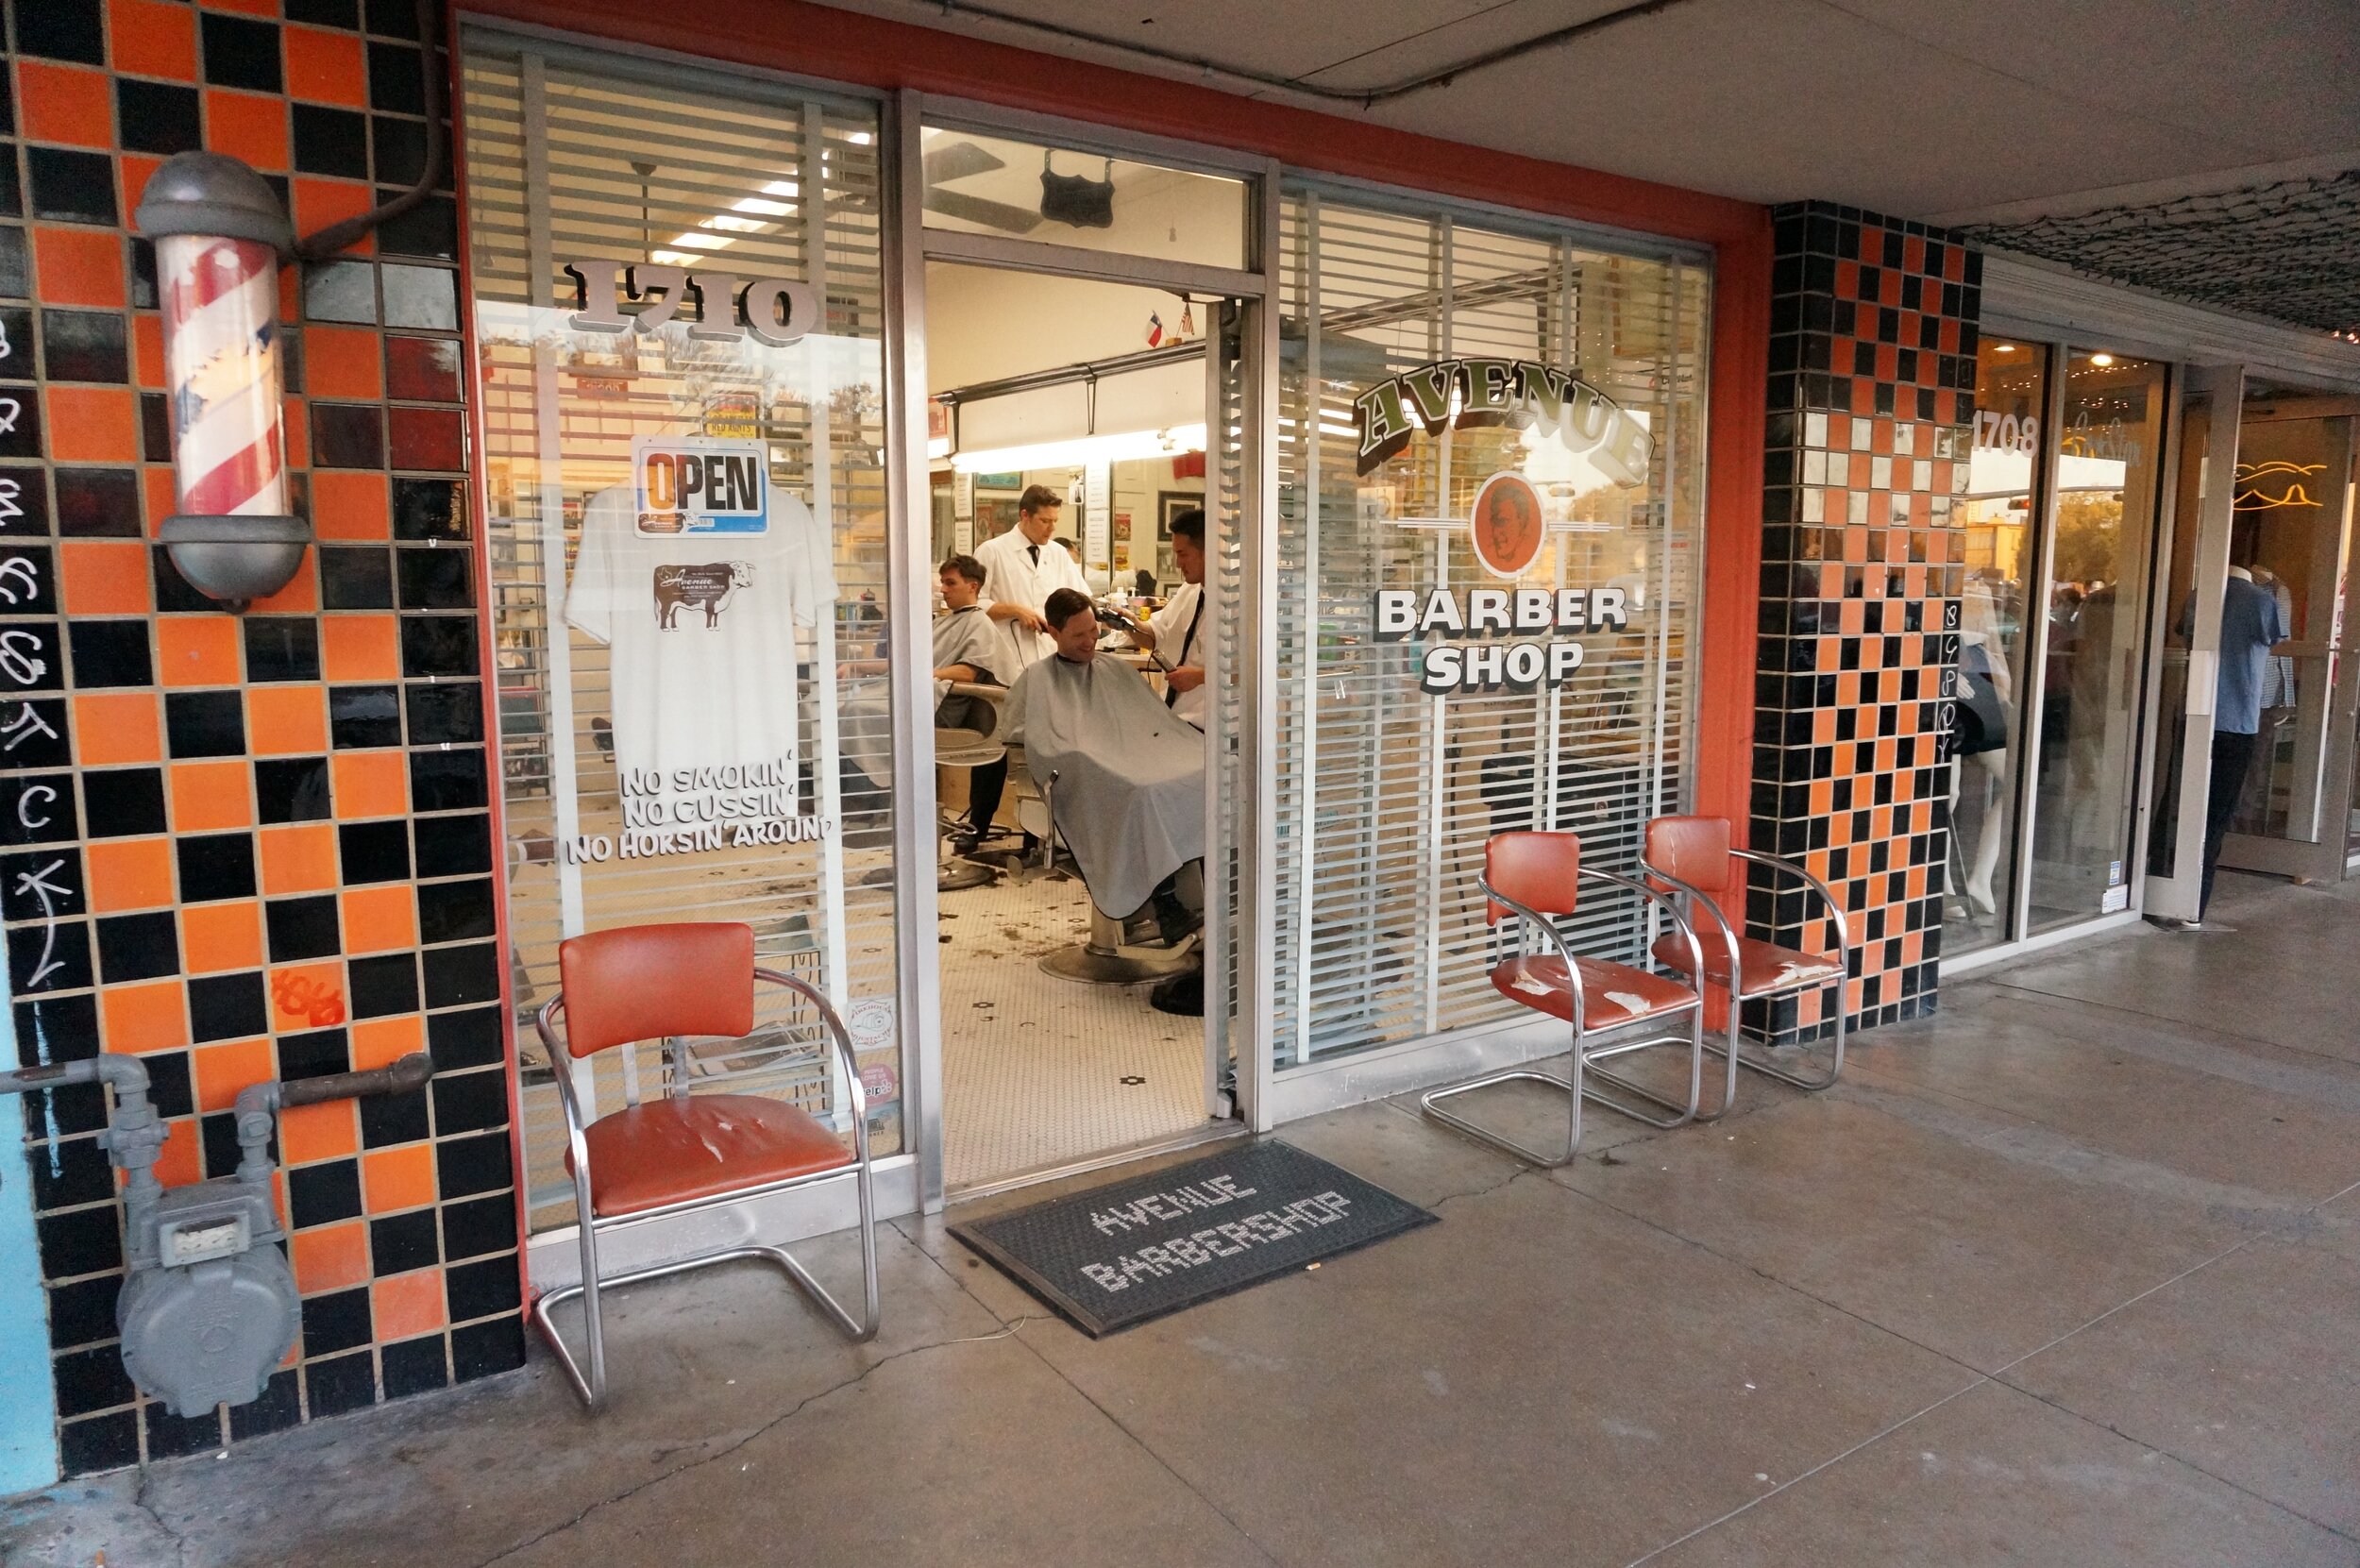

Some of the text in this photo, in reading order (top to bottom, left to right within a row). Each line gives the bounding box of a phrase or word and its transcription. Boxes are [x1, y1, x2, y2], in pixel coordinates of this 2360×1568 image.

[564, 260, 818, 347] 1710
[1352, 357, 1656, 490] AVENUE
[1972, 409, 2039, 459] 1708
[647, 452, 759, 511] OPEN
[660, 568, 714, 587] Avenue
[1373, 587, 1628, 642] BARBER
[1420, 642, 1585, 695] SHOP
[621, 767, 661, 798] NO
[566, 835, 613, 866] NO
[733, 815, 834, 849] AROUND
[622, 798, 664, 830] NO
[1089, 1174, 1258, 1236] AVENUE
[1080, 1190, 1352, 1293] BARBERSHOP
